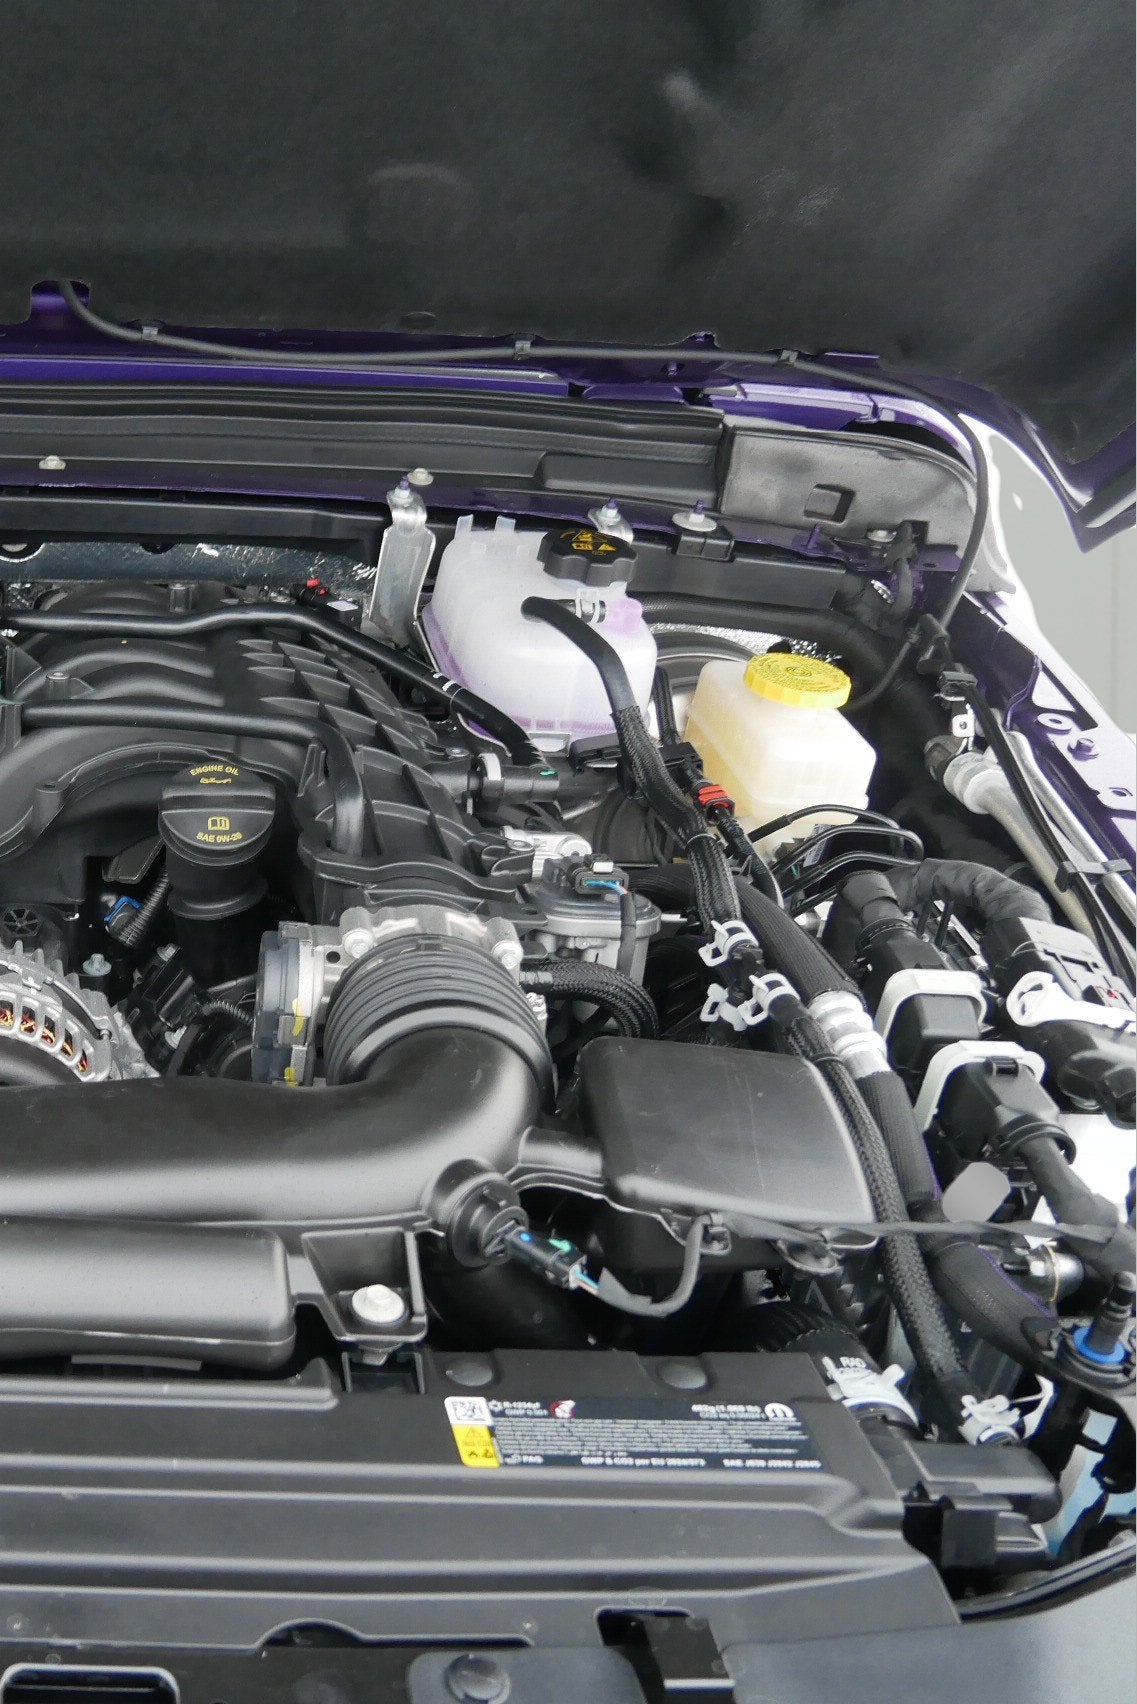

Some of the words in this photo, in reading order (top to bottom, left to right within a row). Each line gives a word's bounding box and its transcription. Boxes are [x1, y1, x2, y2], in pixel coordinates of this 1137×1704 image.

[189, 764, 224, 776] ENGINE
[225, 766, 240, 775] OIL
[196, 832, 215, 842] SAE
